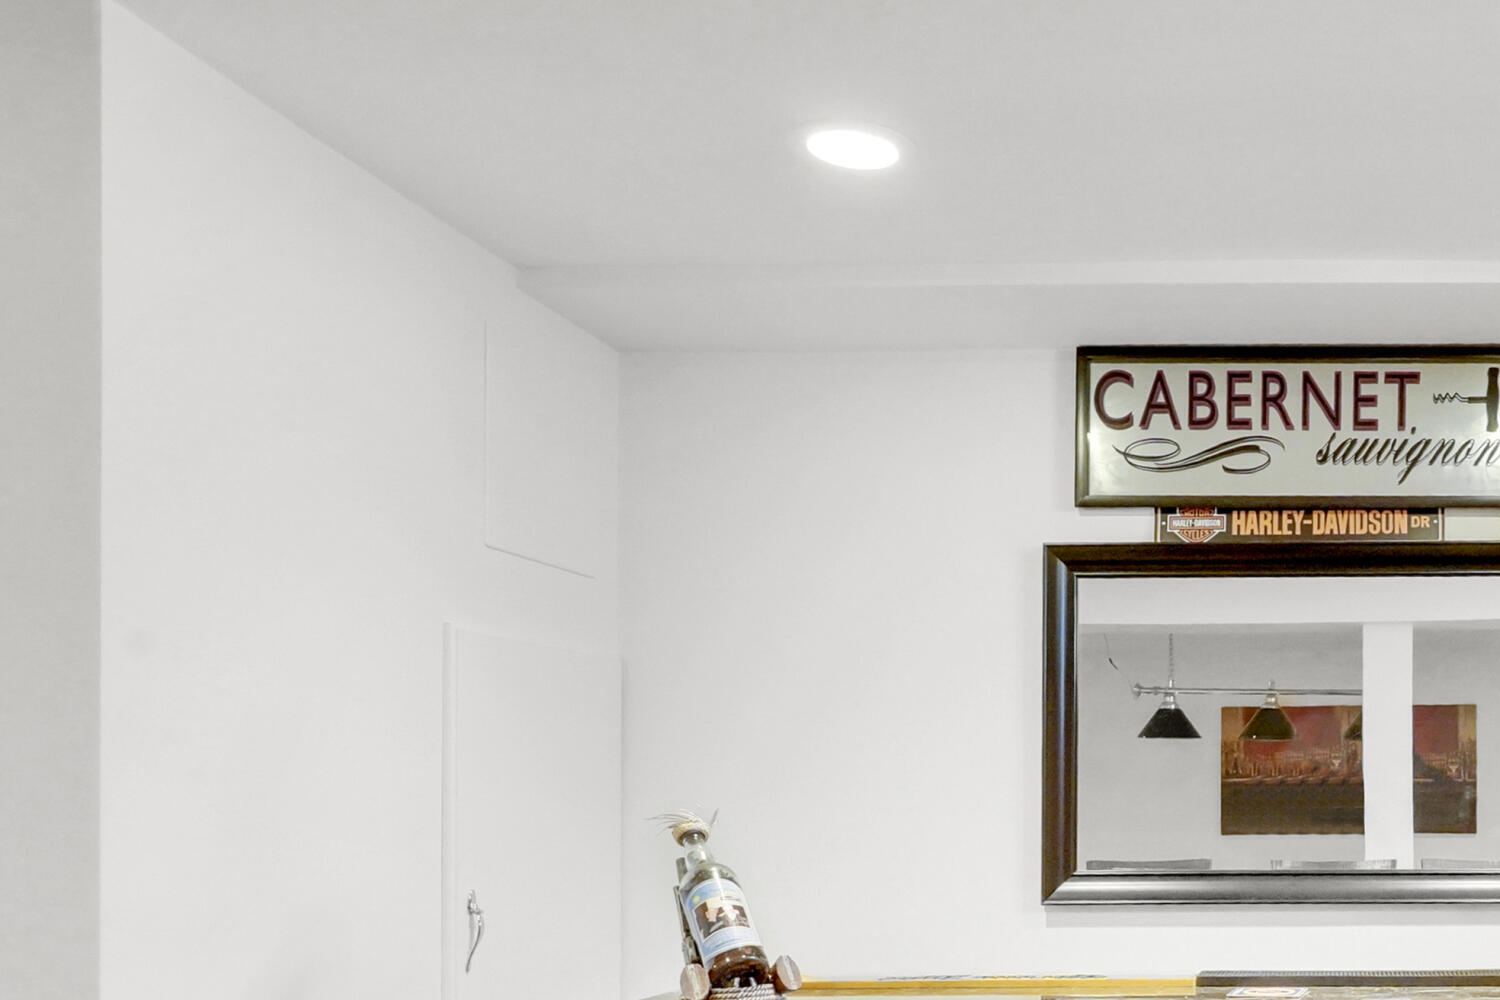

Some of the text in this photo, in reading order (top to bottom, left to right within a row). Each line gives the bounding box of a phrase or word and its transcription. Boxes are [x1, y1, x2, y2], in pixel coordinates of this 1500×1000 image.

[1094, 369, 1421, 431] CABERNET
[1231, 510, 1431, 535] HARLEY-DAVIDSON DR
